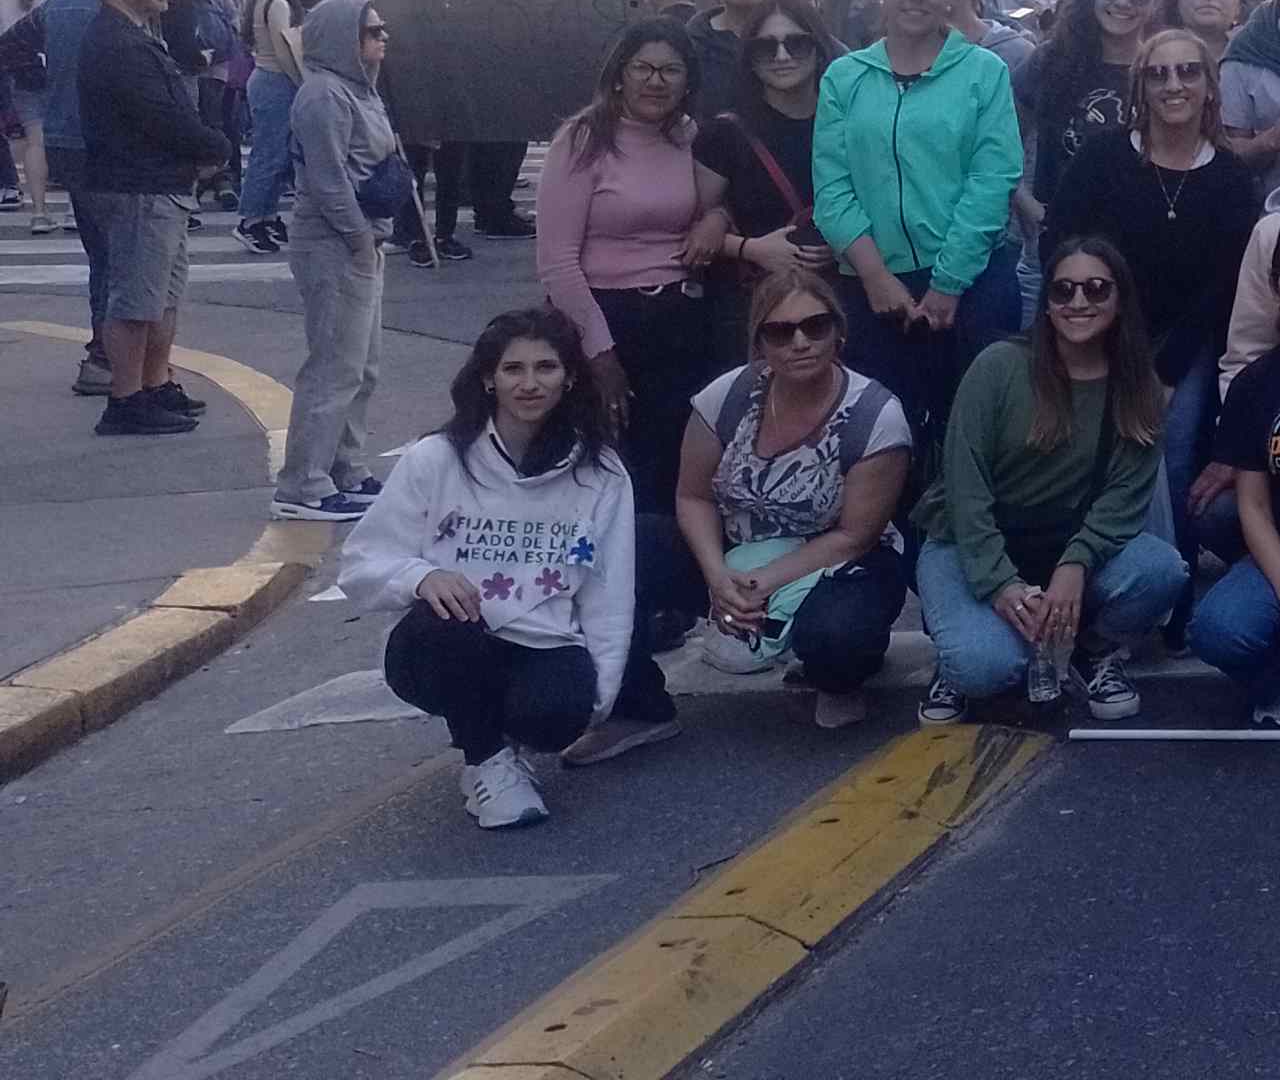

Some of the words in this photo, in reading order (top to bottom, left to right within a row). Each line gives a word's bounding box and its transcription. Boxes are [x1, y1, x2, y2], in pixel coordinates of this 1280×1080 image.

[456, 516, 518, 533] FIJATE
[524, 522, 545, 535] DE
[465, 533, 515, 548] LADO
[550, 538, 567, 552] LA
[456, 547, 519, 563] MECHA
